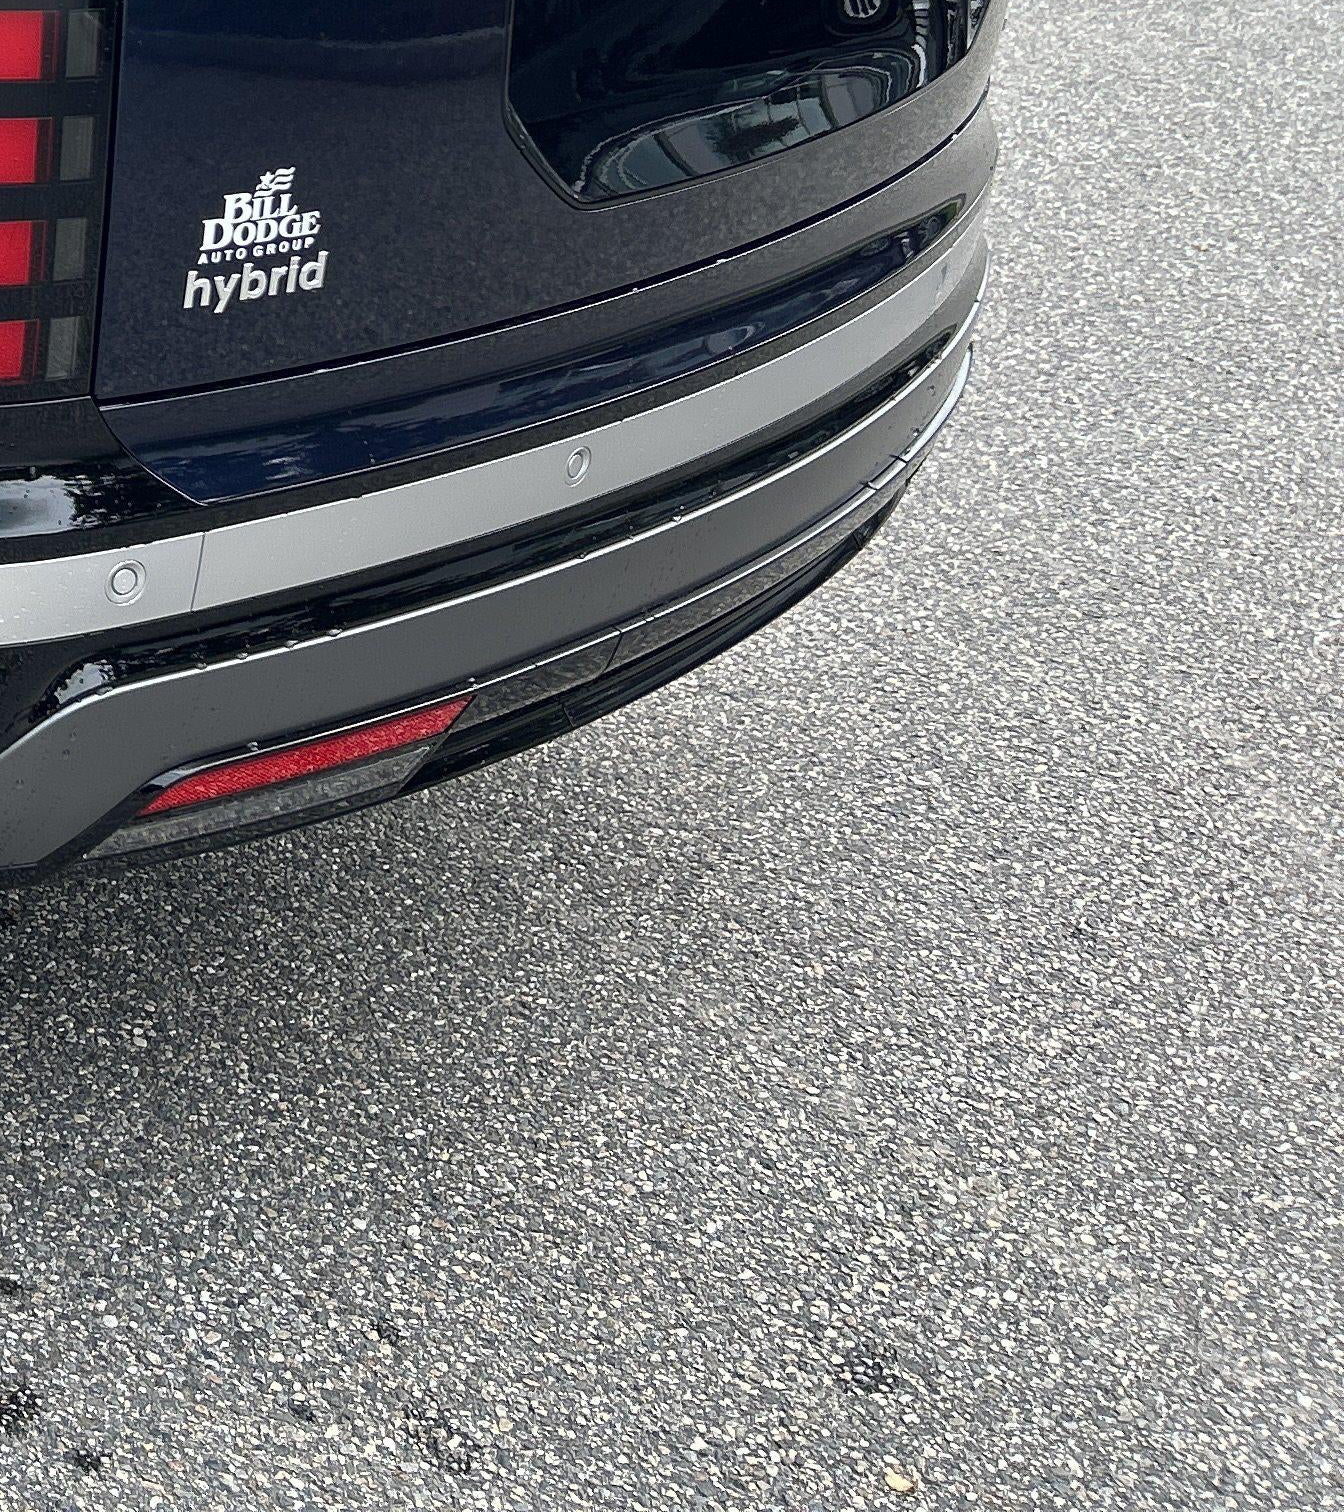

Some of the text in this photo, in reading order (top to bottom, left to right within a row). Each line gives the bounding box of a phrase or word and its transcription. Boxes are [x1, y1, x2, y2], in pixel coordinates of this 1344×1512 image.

[223, 192, 298, 223] BILL
[199, 210, 321, 250] DODGE
[197, 237, 315, 264] AUTO GROUP
[183, 250, 330, 313] hybrid
